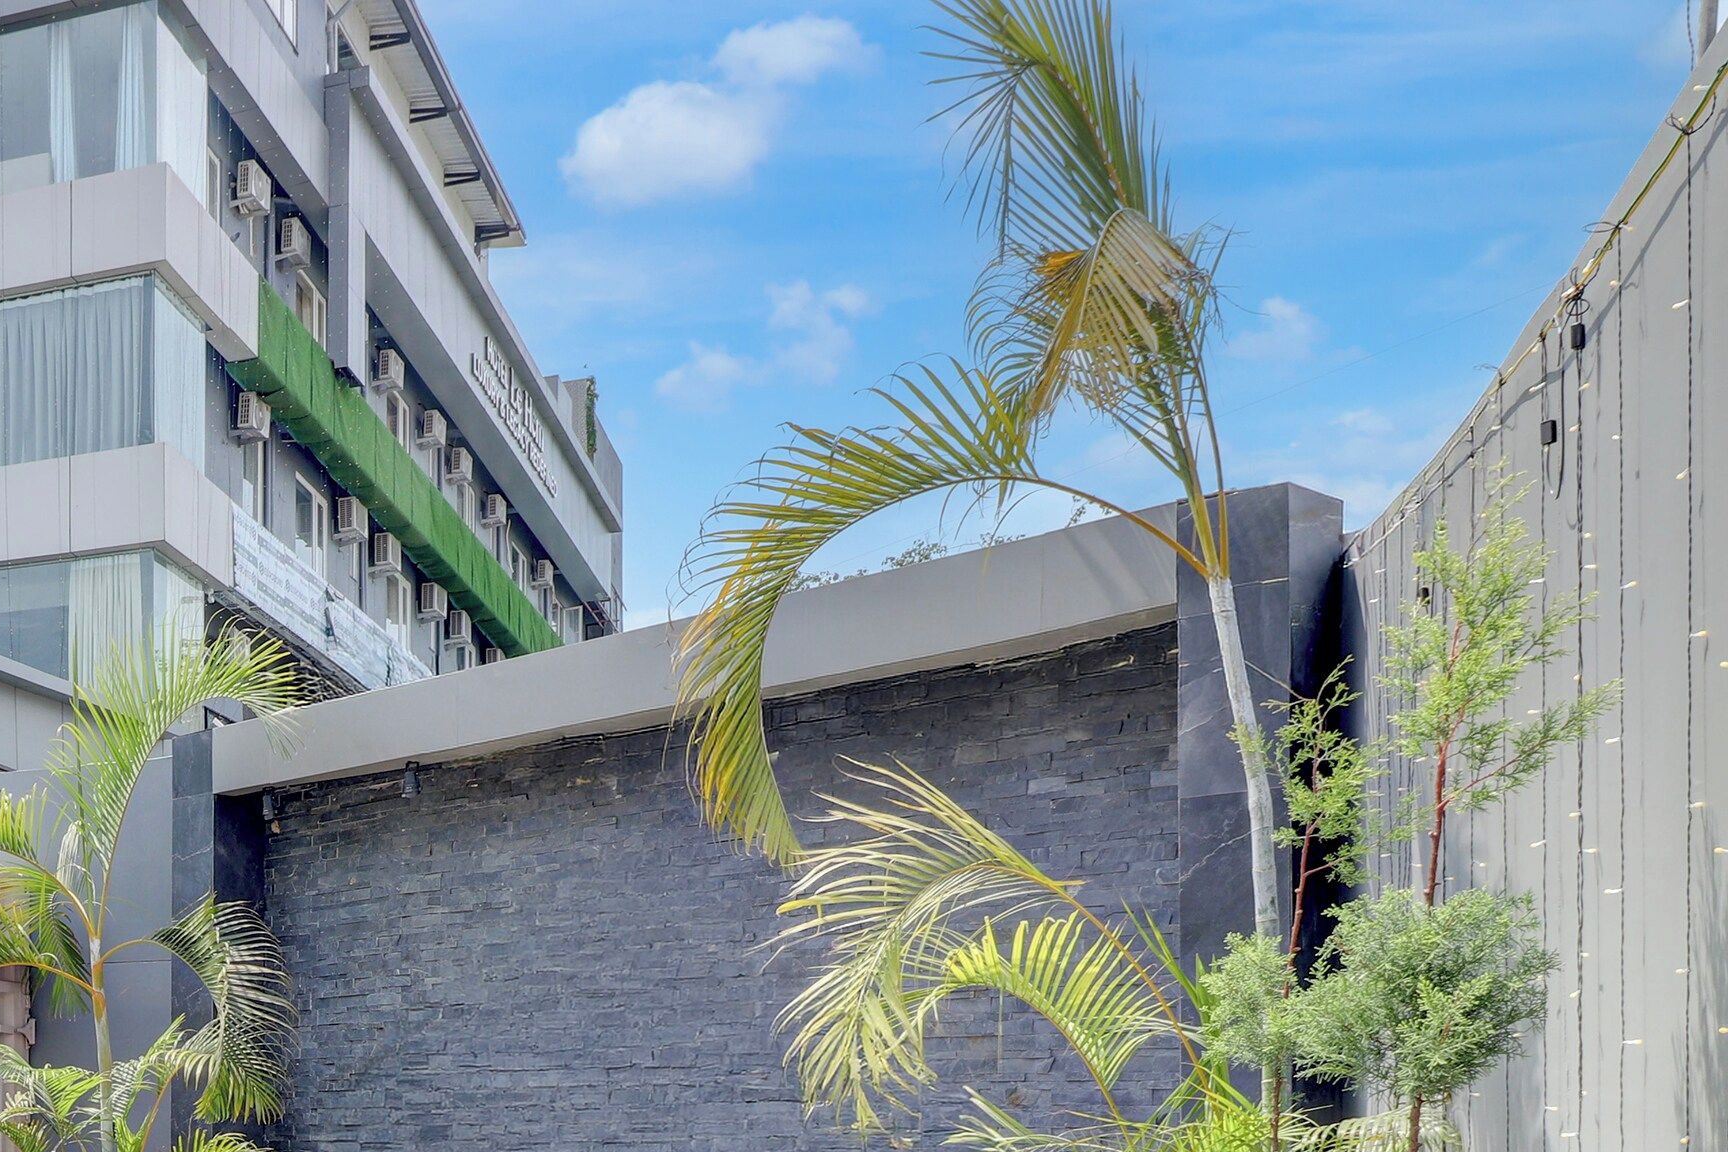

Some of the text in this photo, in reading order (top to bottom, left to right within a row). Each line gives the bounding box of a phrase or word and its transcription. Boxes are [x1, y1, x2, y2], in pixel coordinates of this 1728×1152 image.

[471, 352, 500, 409] LUXURY
[485, 336, 508, 390] HOTEL
[509, 367, 523, 415] Le
